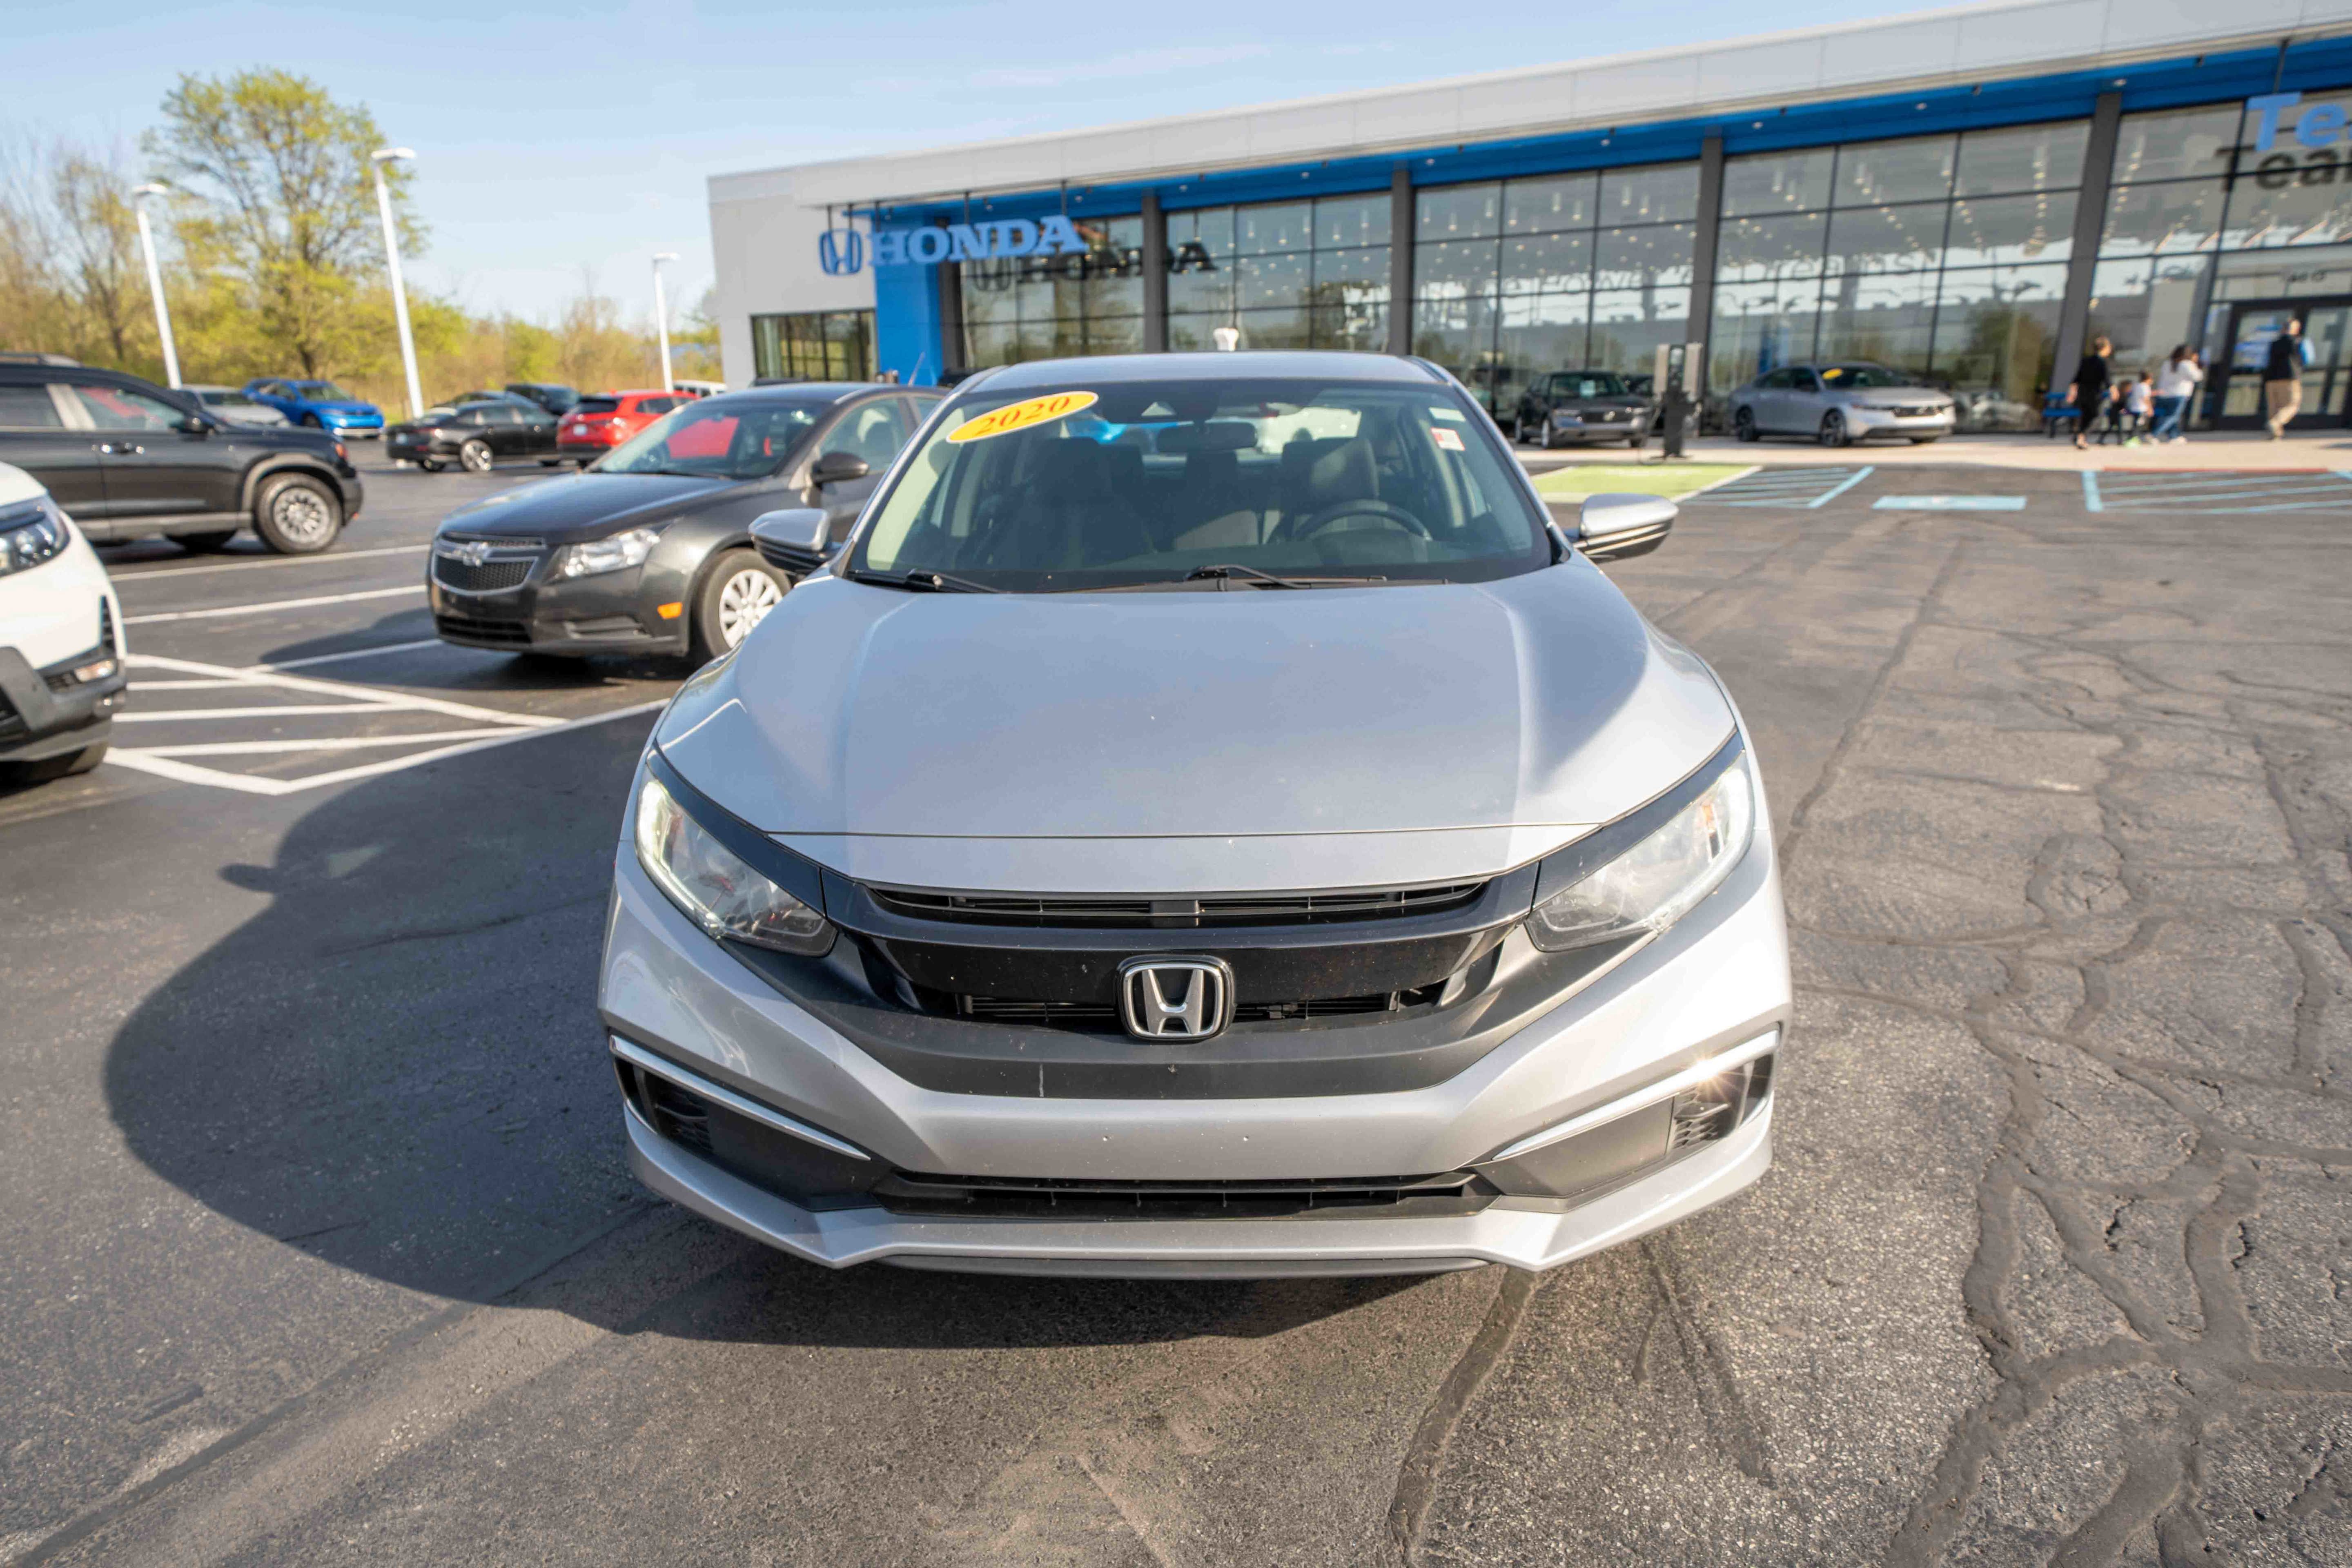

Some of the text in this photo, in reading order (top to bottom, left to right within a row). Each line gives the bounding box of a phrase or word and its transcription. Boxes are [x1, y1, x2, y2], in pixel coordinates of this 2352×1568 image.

[2247, 91, 2352, 151] Te
[868, 214, 1089, 266] HONDA
[973, 397, 1070, 436] 2020
